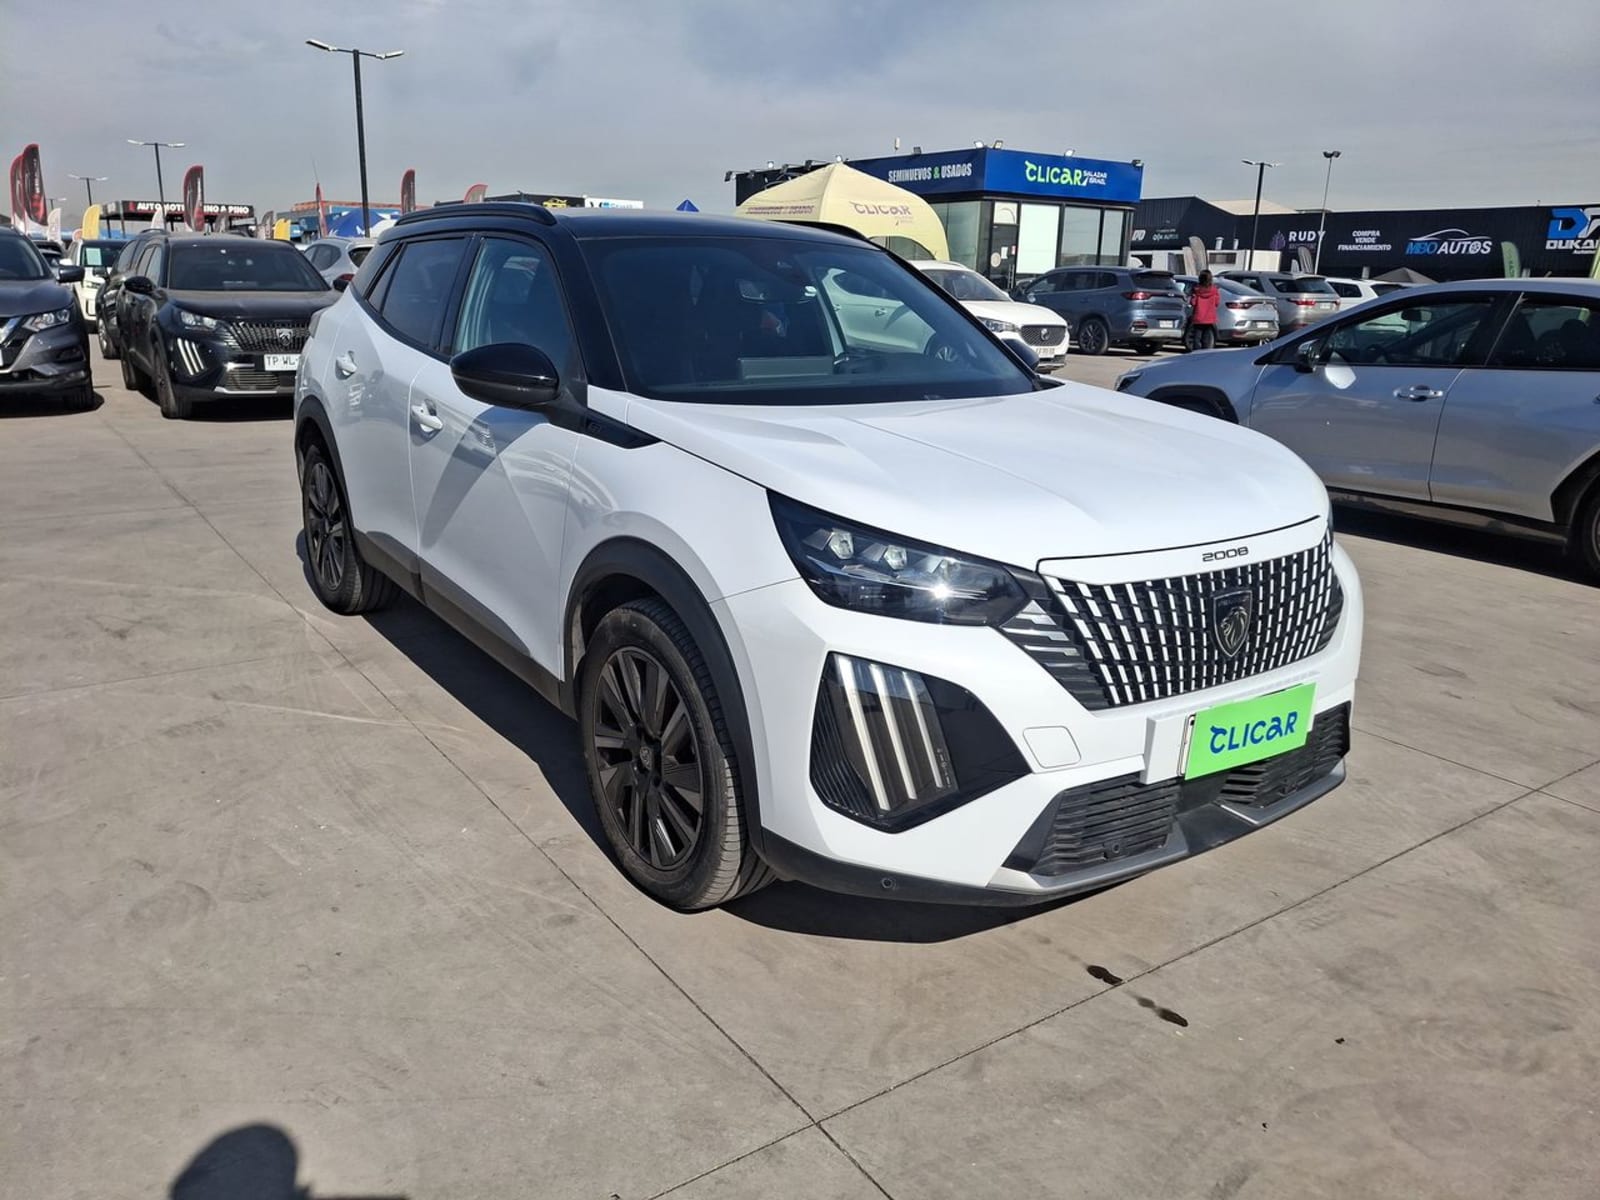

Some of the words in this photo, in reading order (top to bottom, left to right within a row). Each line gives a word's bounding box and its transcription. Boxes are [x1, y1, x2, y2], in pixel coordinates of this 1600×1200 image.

[933, 166, 940, 179] &
[941, 163, 972, 178] USADOS
[1288, 230, 1326, 242] RUDY
[1437, 240, 1493, 255] AUTOS
[1202, 546, 1249, 562] 2008
